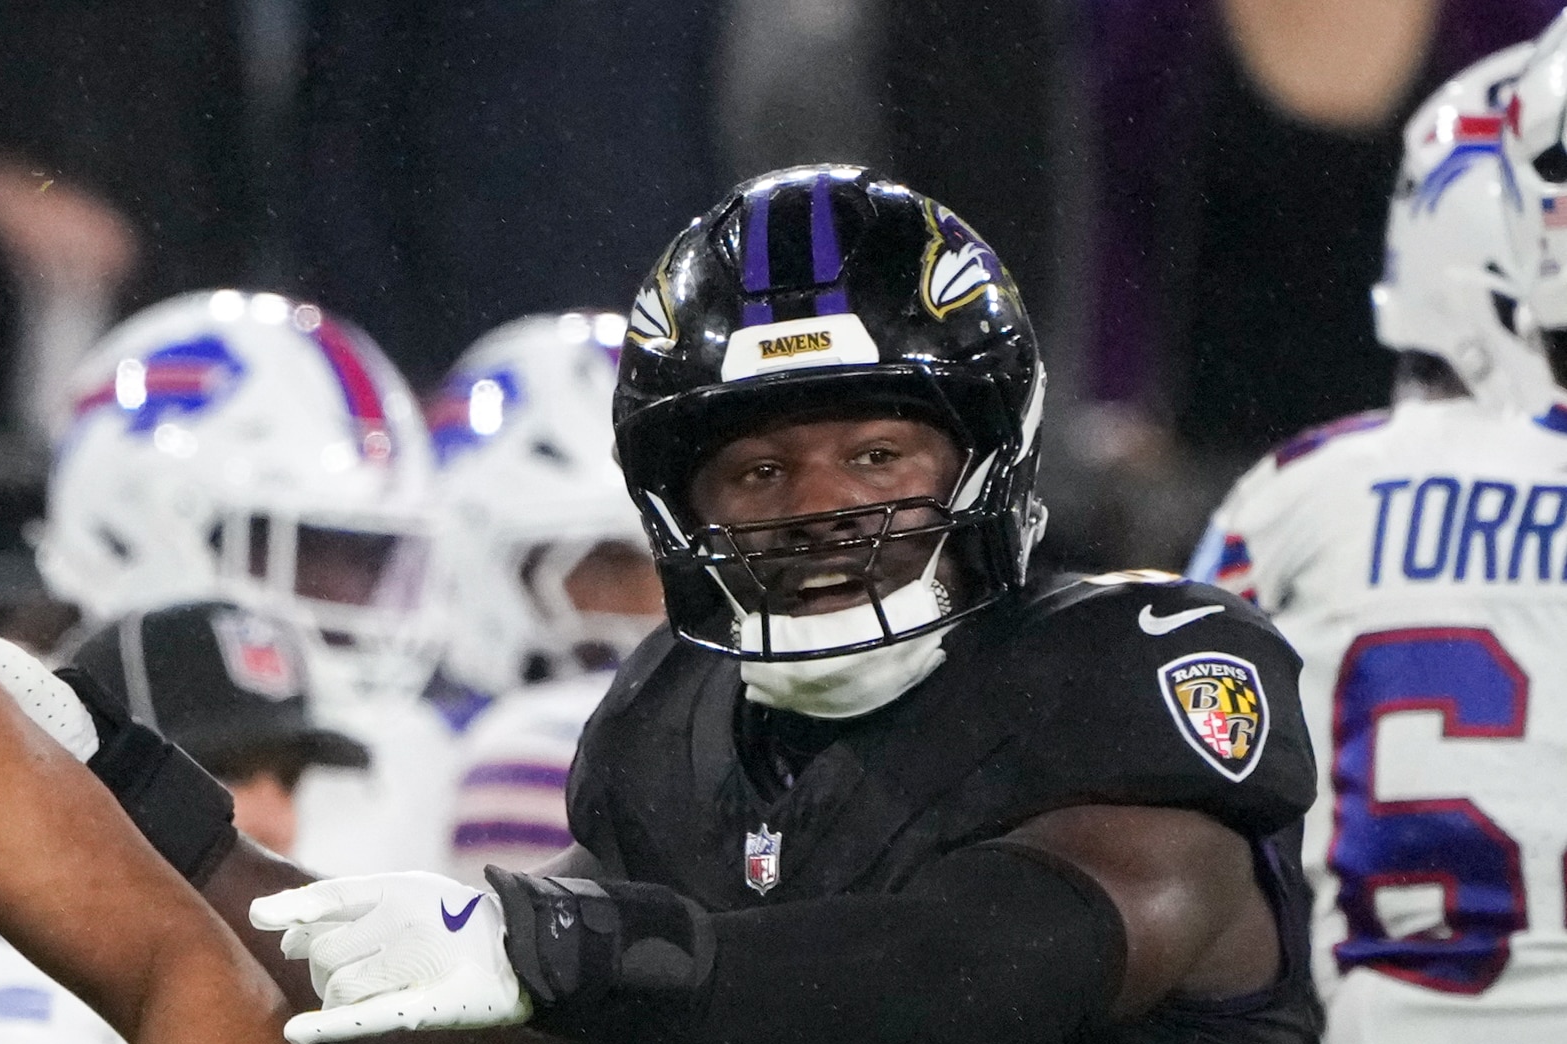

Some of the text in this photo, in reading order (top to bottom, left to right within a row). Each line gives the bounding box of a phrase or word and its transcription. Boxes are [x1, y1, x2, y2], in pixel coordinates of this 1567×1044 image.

[758, 330, 833, 358] RAVENS
[1368, 476, 1567, 586] TORR
[1171, 663, 1248, 683] RAVENS
[1328, 627, 1567, 996] 6
